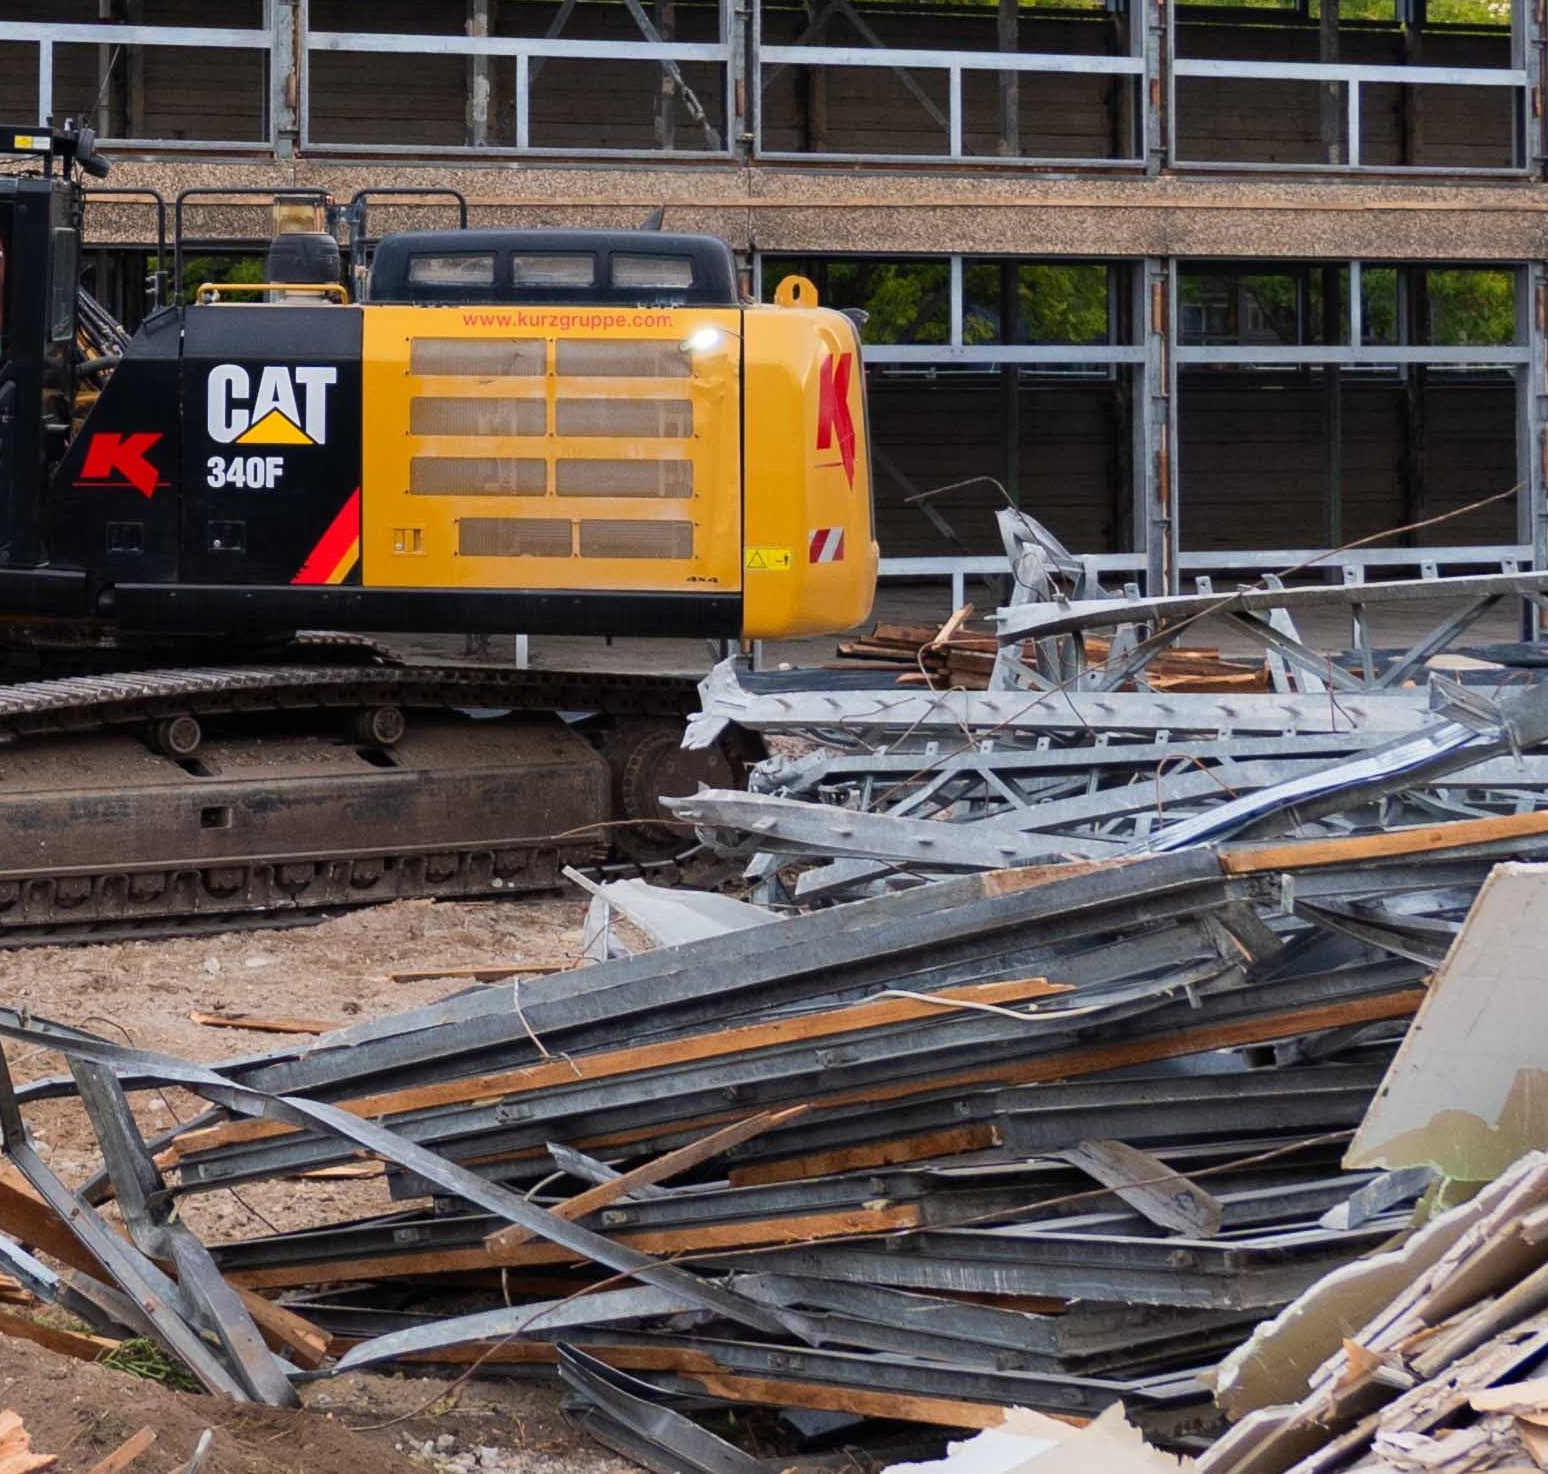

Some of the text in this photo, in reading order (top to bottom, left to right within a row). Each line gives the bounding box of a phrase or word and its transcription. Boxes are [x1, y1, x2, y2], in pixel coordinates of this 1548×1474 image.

[462, 310, 673, 330] www.kurzgruppe.com
[207, 363, 338, 445] CAT
[816, 352, 857, 491] K
[79, 431, 164, 500] K
[206, 456, 284, 488] 340F
